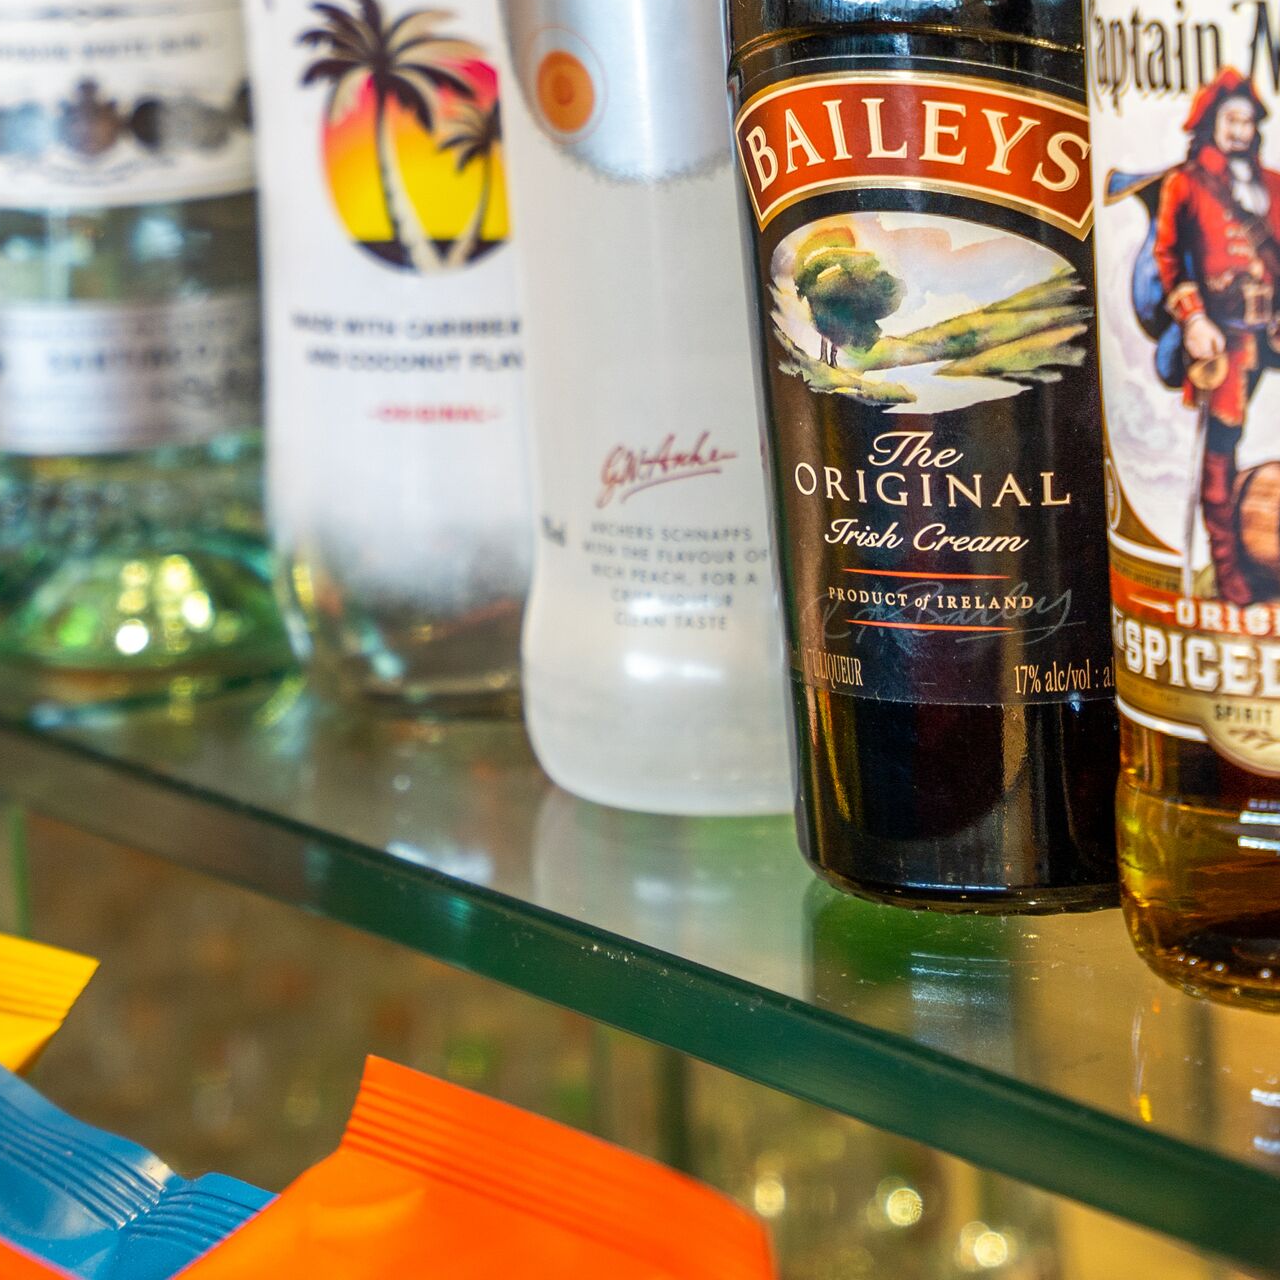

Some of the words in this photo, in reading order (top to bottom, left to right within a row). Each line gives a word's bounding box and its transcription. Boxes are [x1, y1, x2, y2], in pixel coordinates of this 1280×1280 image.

[746, 98, 1092, 193] BAILEYS
[868, 431, 963, 469] The
[794, 462, 1070, 508] ORIGINAL
[824, 518, 904, 549] Irish
[912, 523, 1030, 553] Cream
[829, 586, 908, 608] PRODUCT
[914, 593, 931, 612] of
[937, 596, 1034, 610] IRELAND
[1013, 665, 1041, 695] 17%
[1045, 659, 1091, 692] alc/vol
